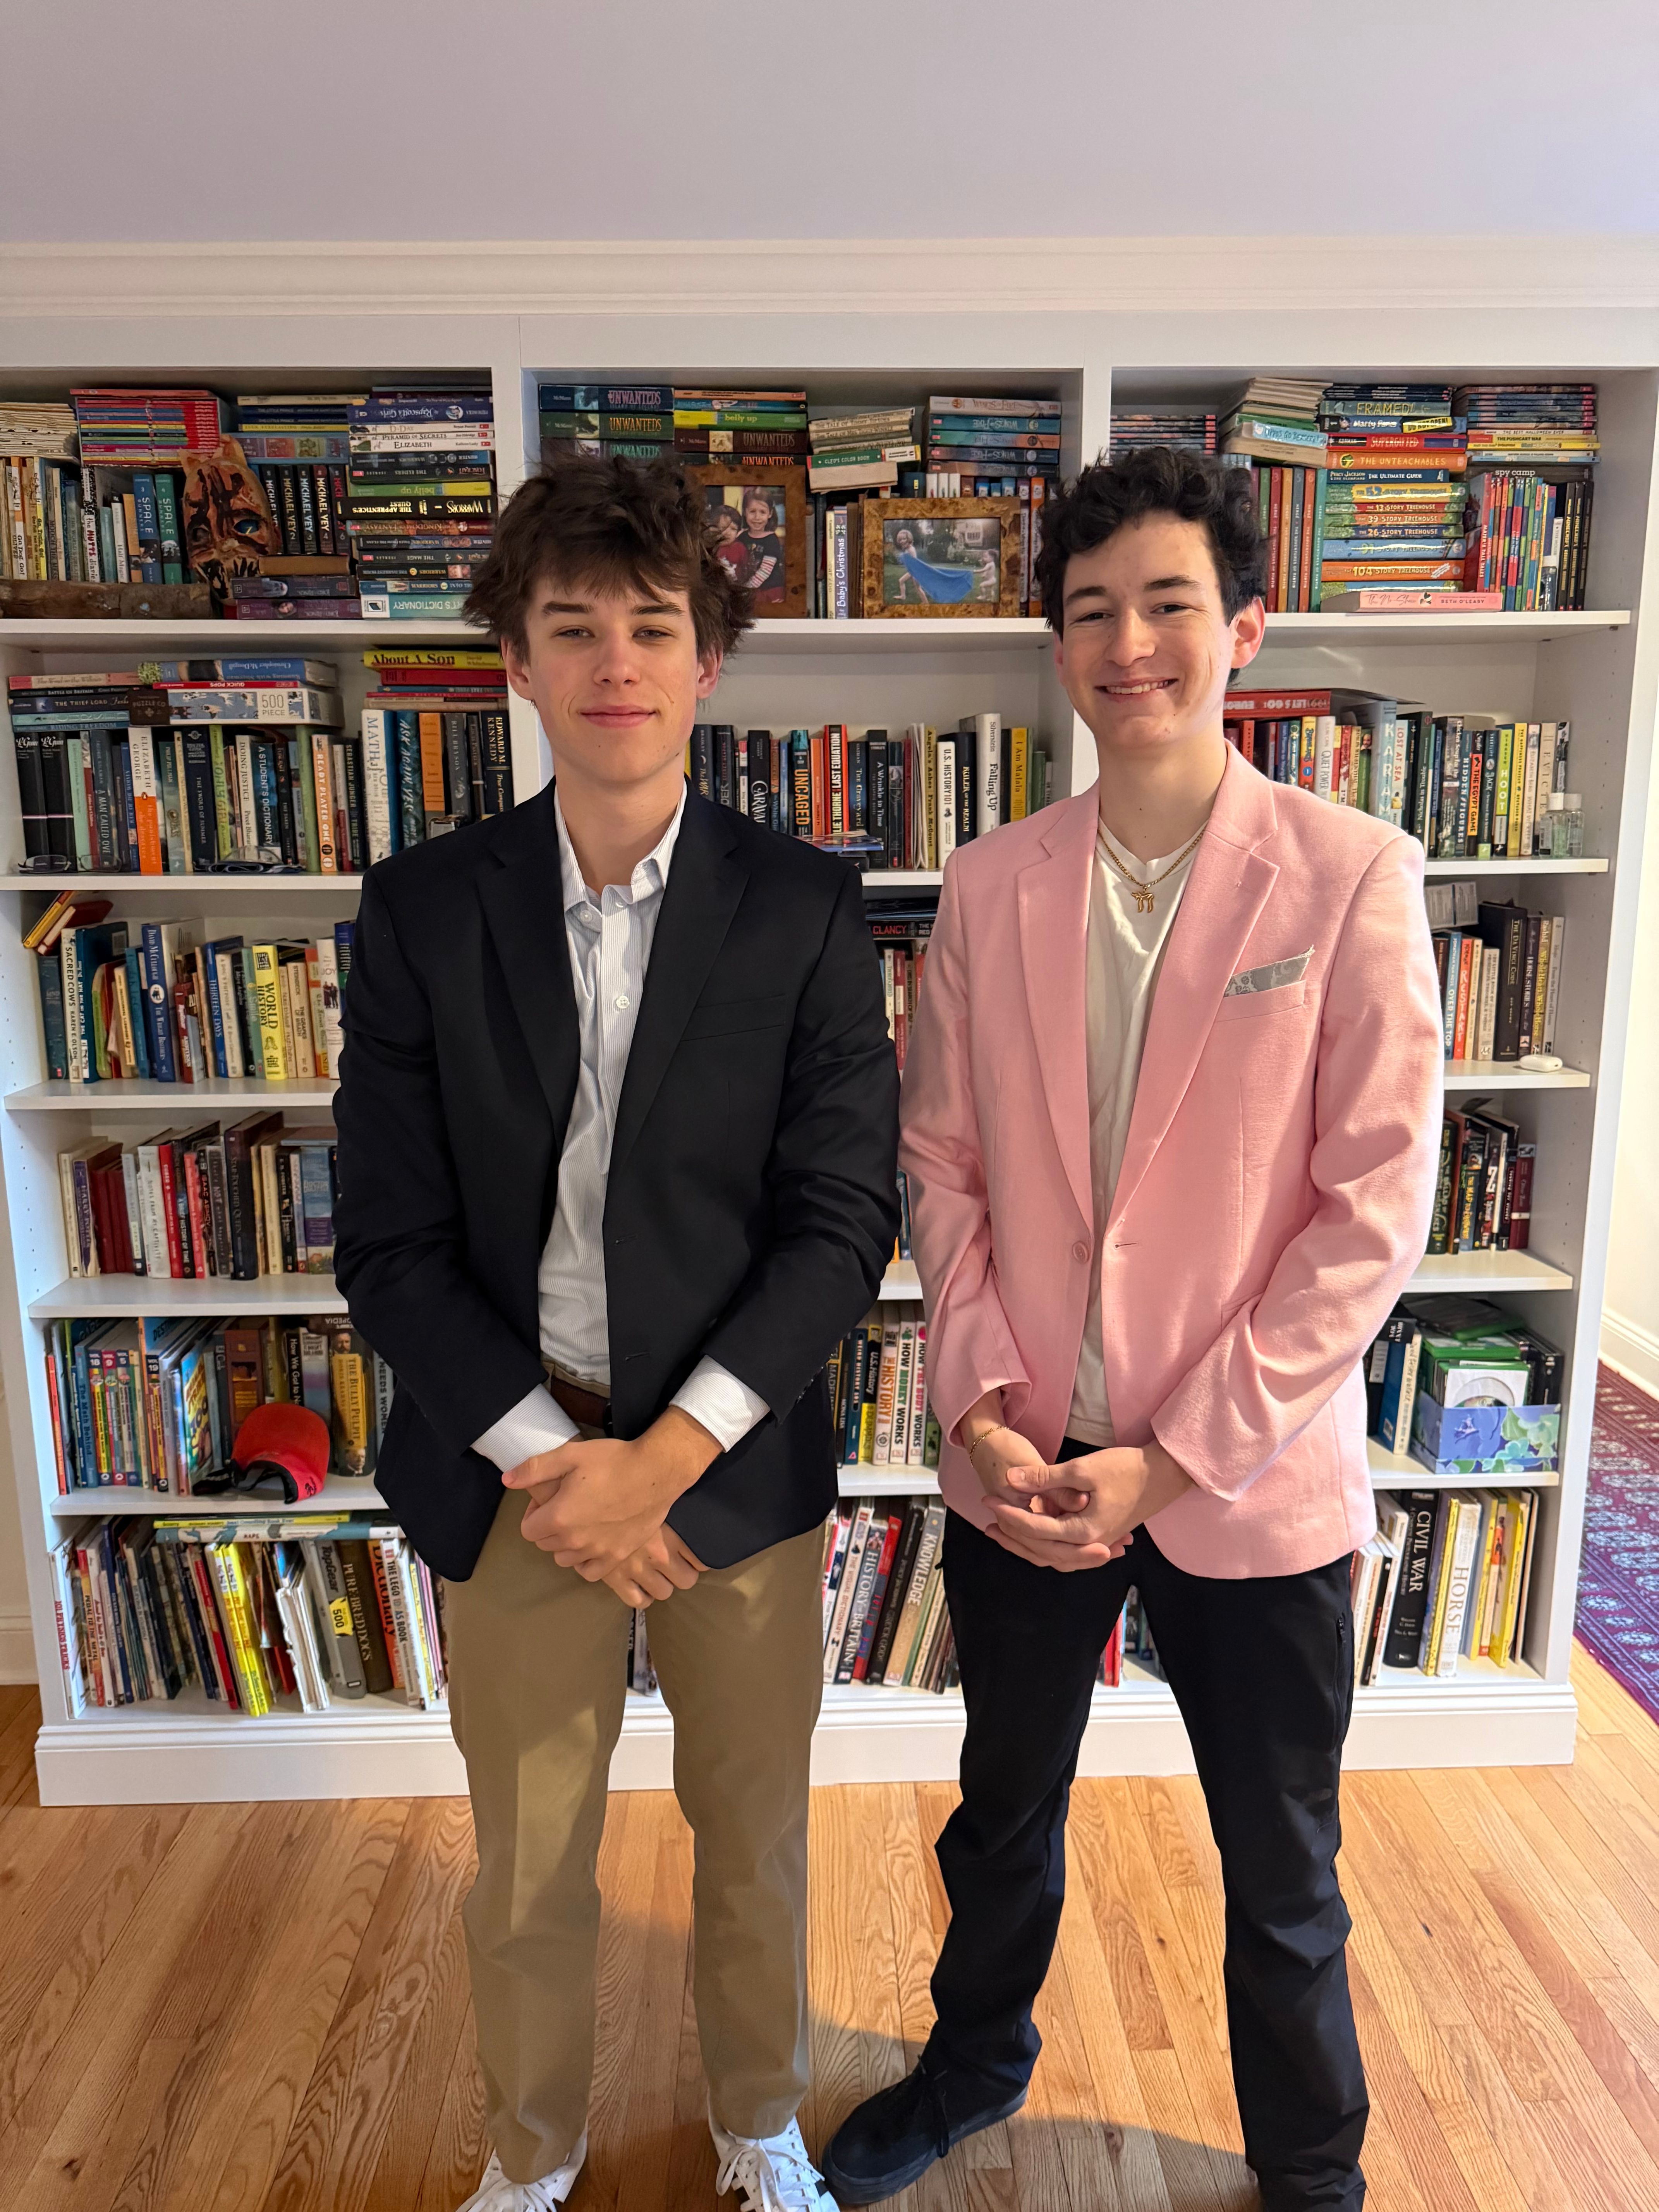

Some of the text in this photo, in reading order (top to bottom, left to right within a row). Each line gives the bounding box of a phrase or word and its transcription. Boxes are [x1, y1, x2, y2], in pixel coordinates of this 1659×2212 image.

[380, 409, 397, 417] Girls
[609, 417, 661, 431] UNWANTEDS
[725, 414, 744, 422] belly
[1353, 420, 1376, 428] Marty
[1357, 402, 1416, 416] FRAMED!
[742, 433, 795, 446] UNWANTEDS
[742, 456, 794, 465] UNWANTEDS
[142, 497, 153, 534] SPACE
[163, 498, 174, 534] SPACE
[300, 478, 313, 532] MICHAEL VEY
[316, 477, 330, 532] MICHAEL VEY
[447, 500, 484, 513] WARRIORS
[86, 518, 94, 528] the
[87, 530, 95, 556] MUTTS
[836, 538, 848, 607] Baby's Christmas
[393, 600, 443, 610] DICTIONARY
[427, 654, 455, 665] Son
[262, 694, 284, 708] 500
[487, 717, 497, 762] KENNEDY
[495, 717, 506, 764] EDWARD M.
[831, 733, 841, 769] EQUATION
[1015, 748, 1022, 762] Am
[133, 744, 141, 780] GEORGE
[141, 736, 151, 788] ELIZABETH
[239, 742, 248, 769] DOING
[317, 754, 325, 783] READY
[400, 719, 414, 812] ASK AGAIN, YES
[943, 749, 951, 762] U.S.
[1319, 750, 1331, 789] QUIET POWER
[1396, 753, 1403, 763] AT
[240, 771, 250, 802] JUSTICE
[259, 754, 269, 797] STUDENT'S
[831, 771, 841, 788] LAST
[943, 764, 951, 793] HISTORY
[986, 763, 998, 796] Falling
[1499, 769, 1508, 811] HOOT
[99, 797, 107, 812] MAN
[320, 787, 329, 820] PLAYER
[794, 769, 810, 825] UNCAGED
[832, 792, 842, 821] THORNE
[853, 785, 864, 826] Graveyard
[988, 797, 998, 811] Up
[1457, 758, 1469, 843] HIDDEN FIGURES
[100, 814, 109, 838] CALLED
[262, 799, 273, 845] DICTIONARY
[102, 840, 110, 853] OVE
[872, 926, 907, 934] CLANCY
[1512, 935, 1519, 945] DA
[1541, 920, 1549, 942] Rashid
[1511, 946, 1519, 965] VINCI
[65, 947, 76, 1006] SACRED COWS
[209, 979, 222, 1037] THIRTEEN DAYS
[257, 986, 268, 1027] HISTORY
[263, 982, 278, 1029] WORLD
[291, 1356, 299, 1370] We
[292, 1371, 300, 1385] Got
[866, 1351, 879, 1395] U.S. History
[349, 1358, 361, 1440] THE BULLY PULPIT
[878, 1365, 895, 1417] HISTORY
[894, 1343, 912, 1444] HOW MONEY WORKS
[1408, 1511, 1432, 1593] CIVIL WAR
[322, 1546, 338, 1592] TopGear
[857, 1551, 879, 1607] HISTORY
[907, 1533, 938, 1607] KNOWLEDGE
[389, 1577, 400, 1596] LEGO
[1446, 1567, 1470, 1635] HORSE
[333, 1608, 345, 1628] 500
[397, 1621, 407, 1643] BOOK
[843, 1613, 864, 1662] BRITAIN
